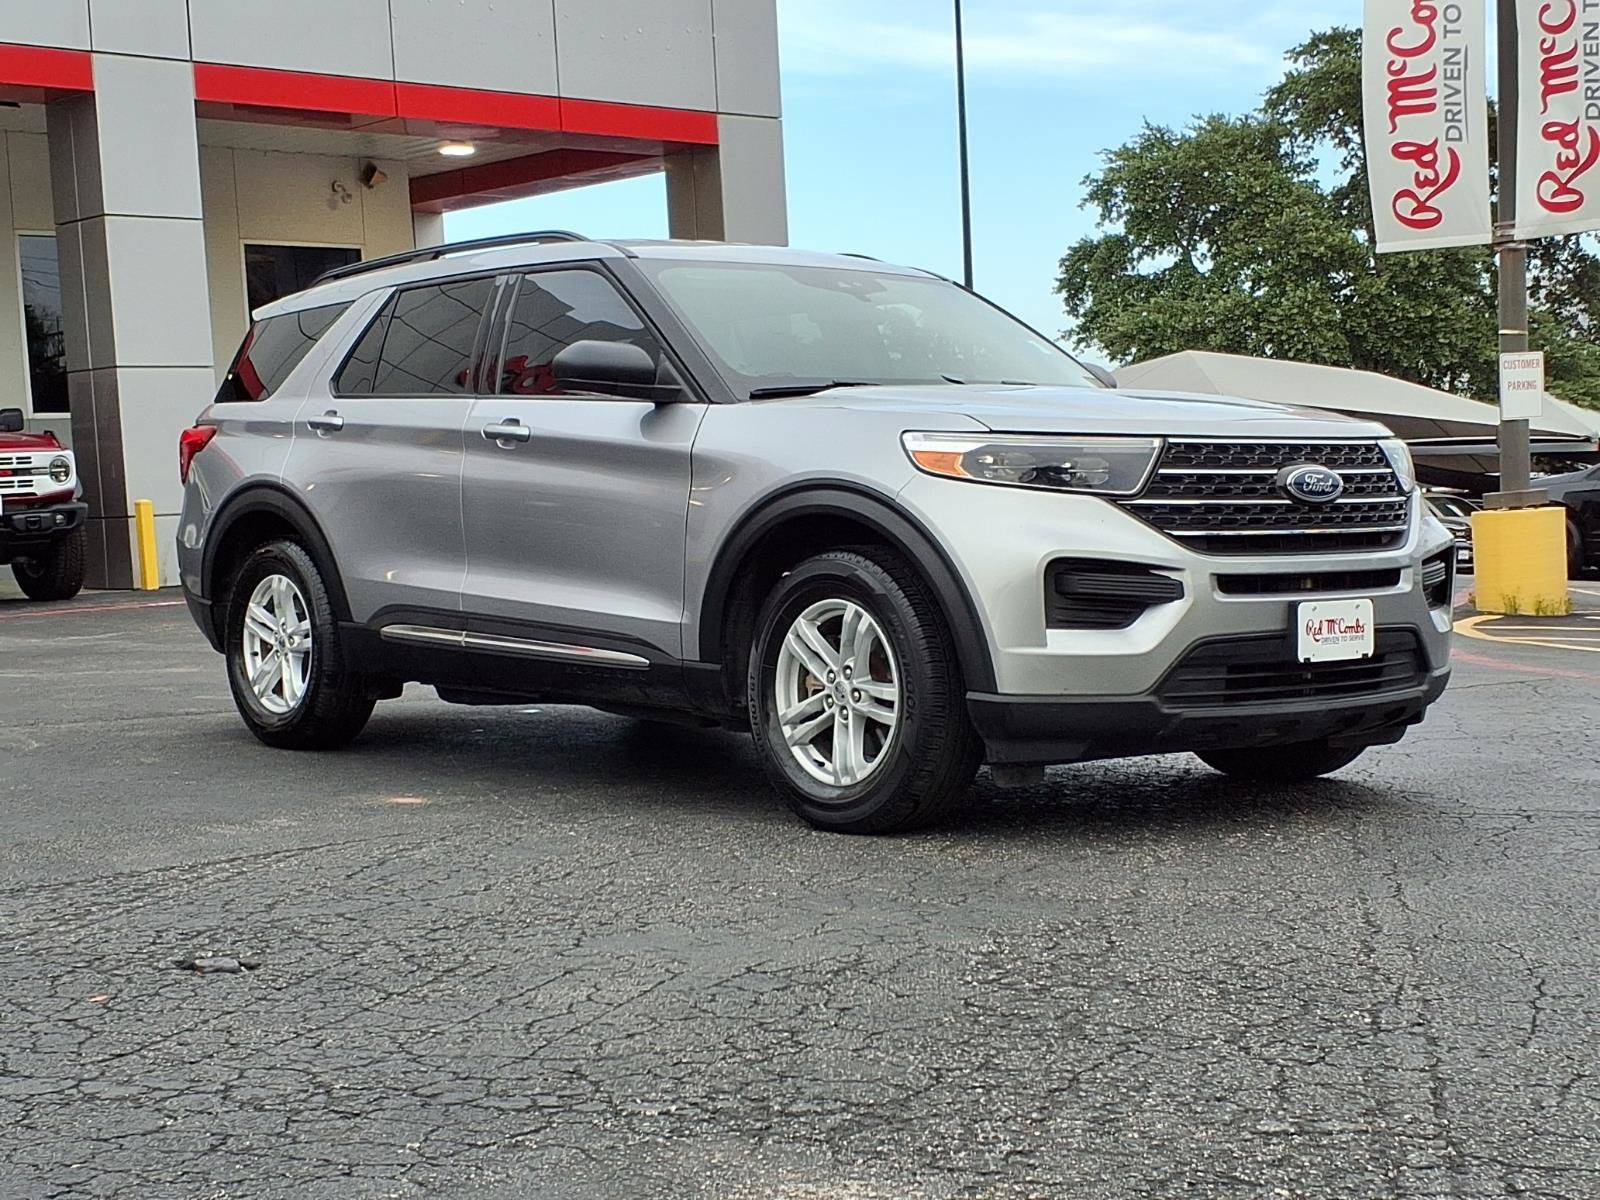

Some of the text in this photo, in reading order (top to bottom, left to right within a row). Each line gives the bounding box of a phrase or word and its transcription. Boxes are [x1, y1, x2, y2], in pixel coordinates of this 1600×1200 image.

[1443, 4, 1463, 143] DRIVEN TO
[1583, 22, 1600, 120] DRIVEN
[1391, 137, 1461, 229] Red
[1536, 116, 1600, 213] Red
[1503, 359, 1540, 370] CUSTOMER
[1507, 381, 1537, 390] PARKING
[1303, 473, 1333, 492] Ford
[1306, 618, 1366, 642] Red McCombs
